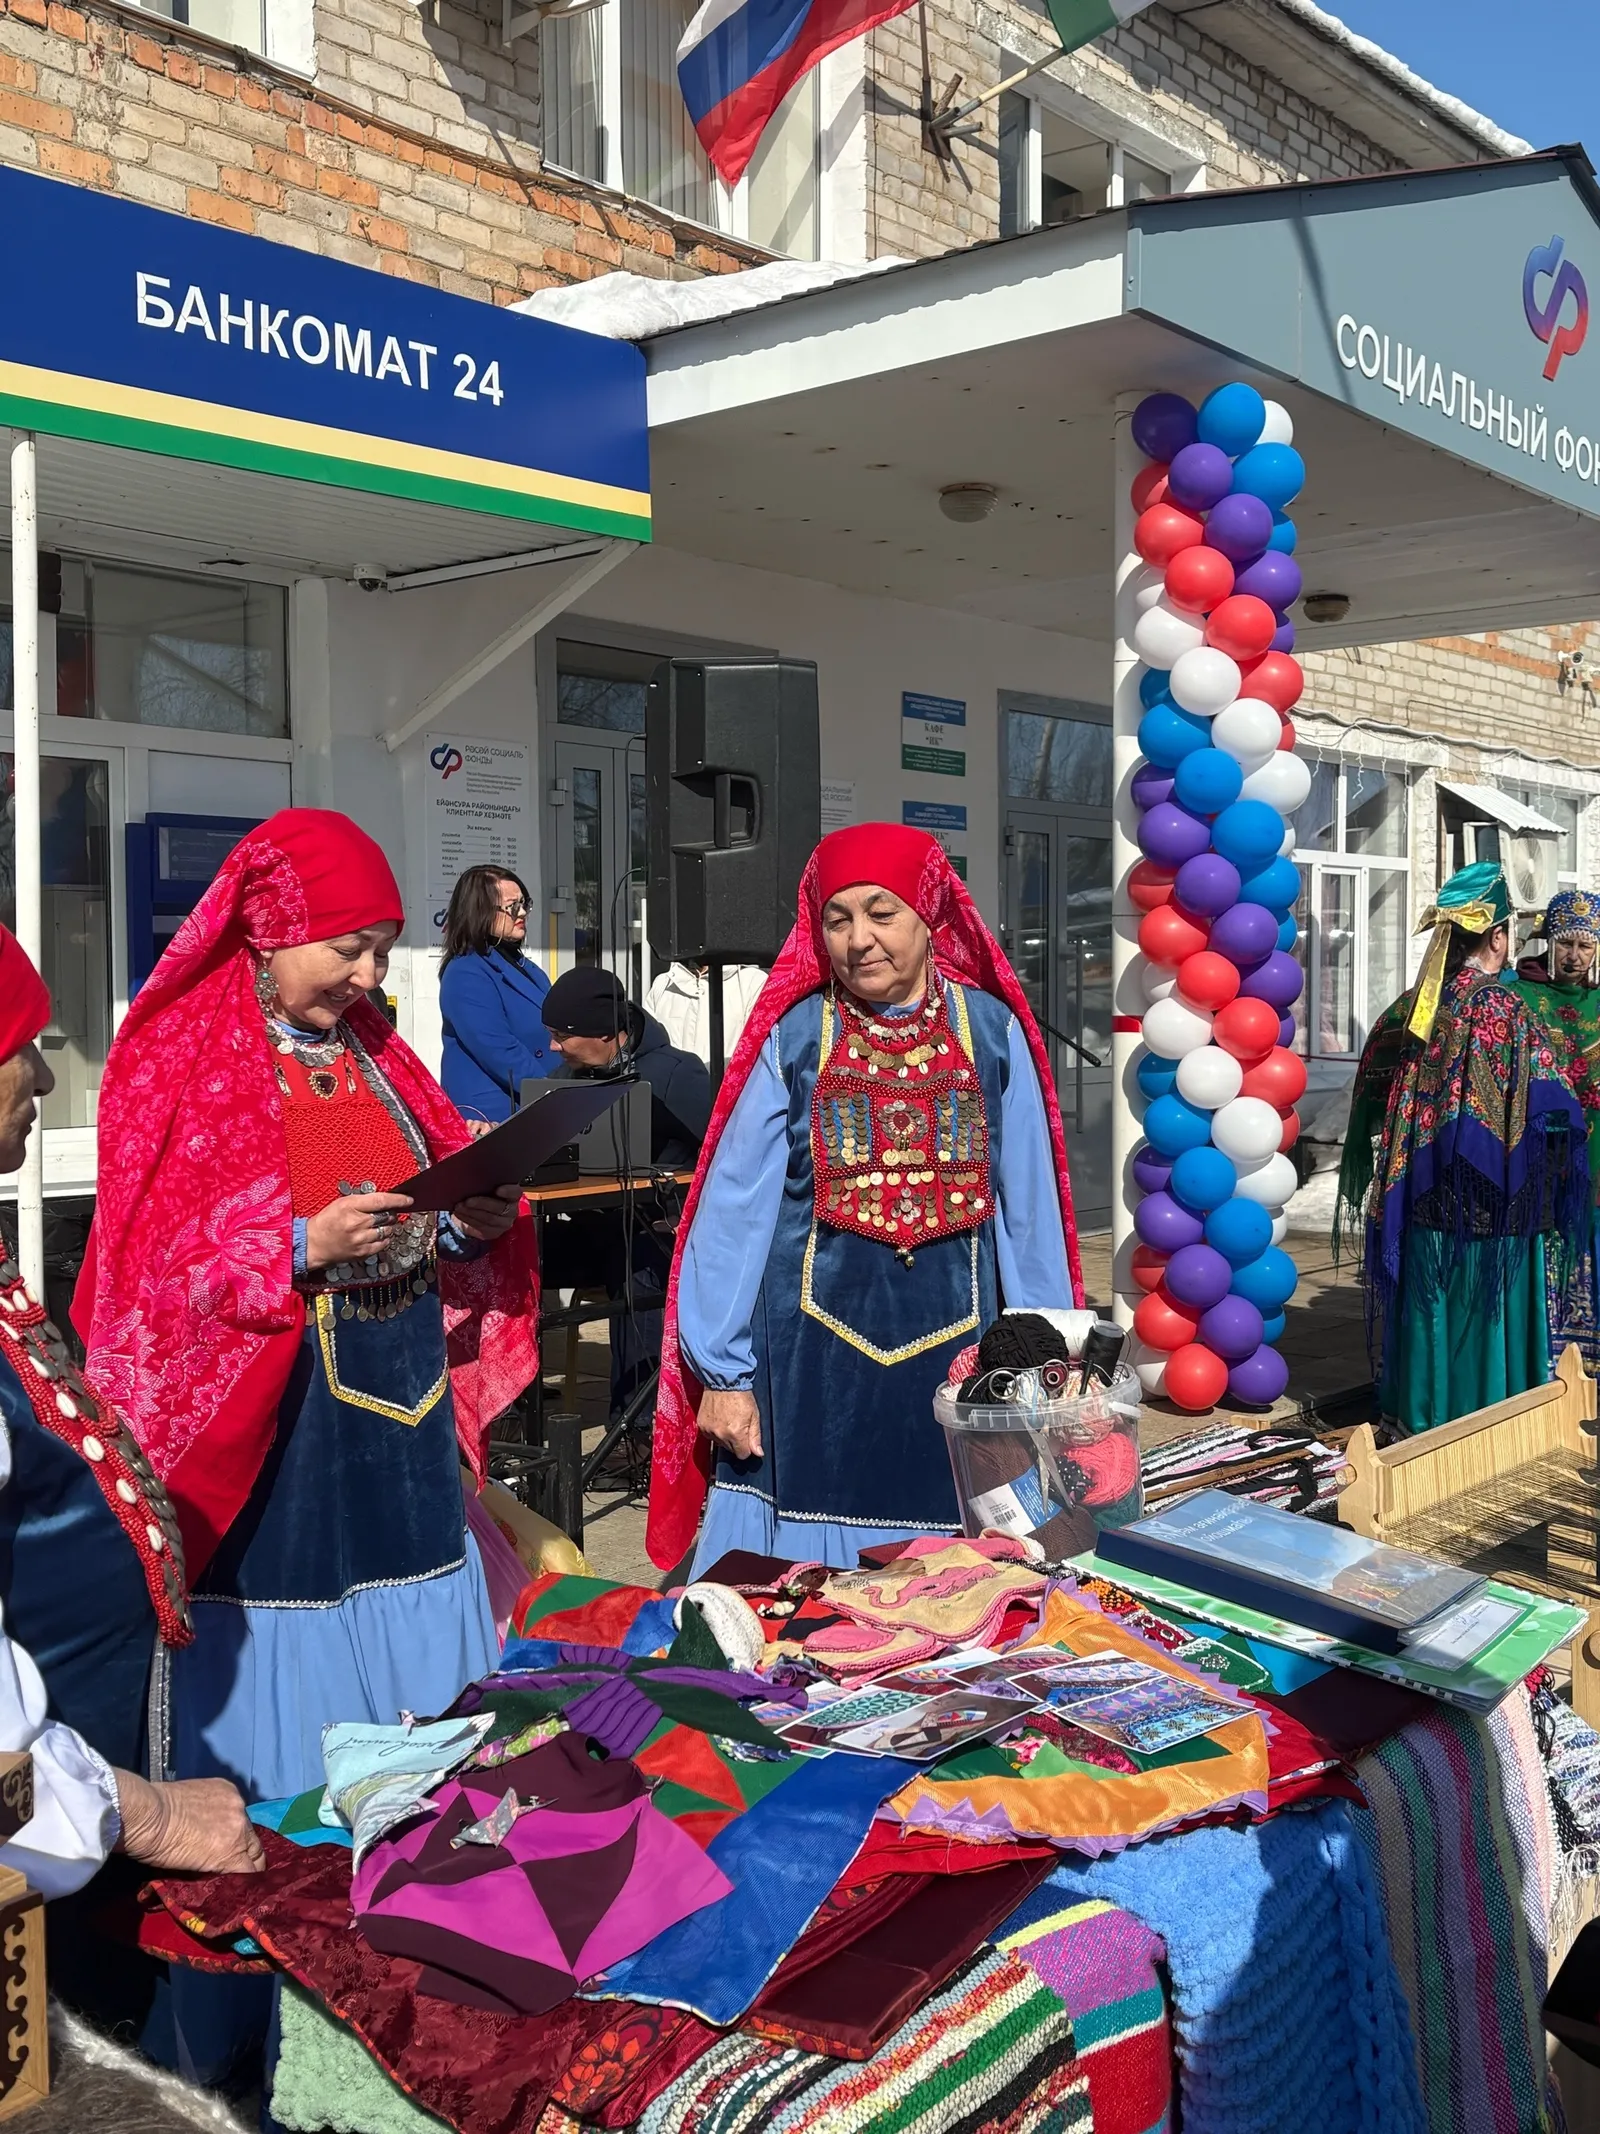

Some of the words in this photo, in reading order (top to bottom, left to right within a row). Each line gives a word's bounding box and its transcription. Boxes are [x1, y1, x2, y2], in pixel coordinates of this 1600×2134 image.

[136, 271, 438, 390] БАНКОМАТ
[453, 353, 504, 407] 24
[1336, 313, 1549, 463] СОЦИАЛЬНЫЙ
[465, 755, 493, 765] ФОНДЫ
[490, 748, 524, 759] СОЦИАЛЬ
